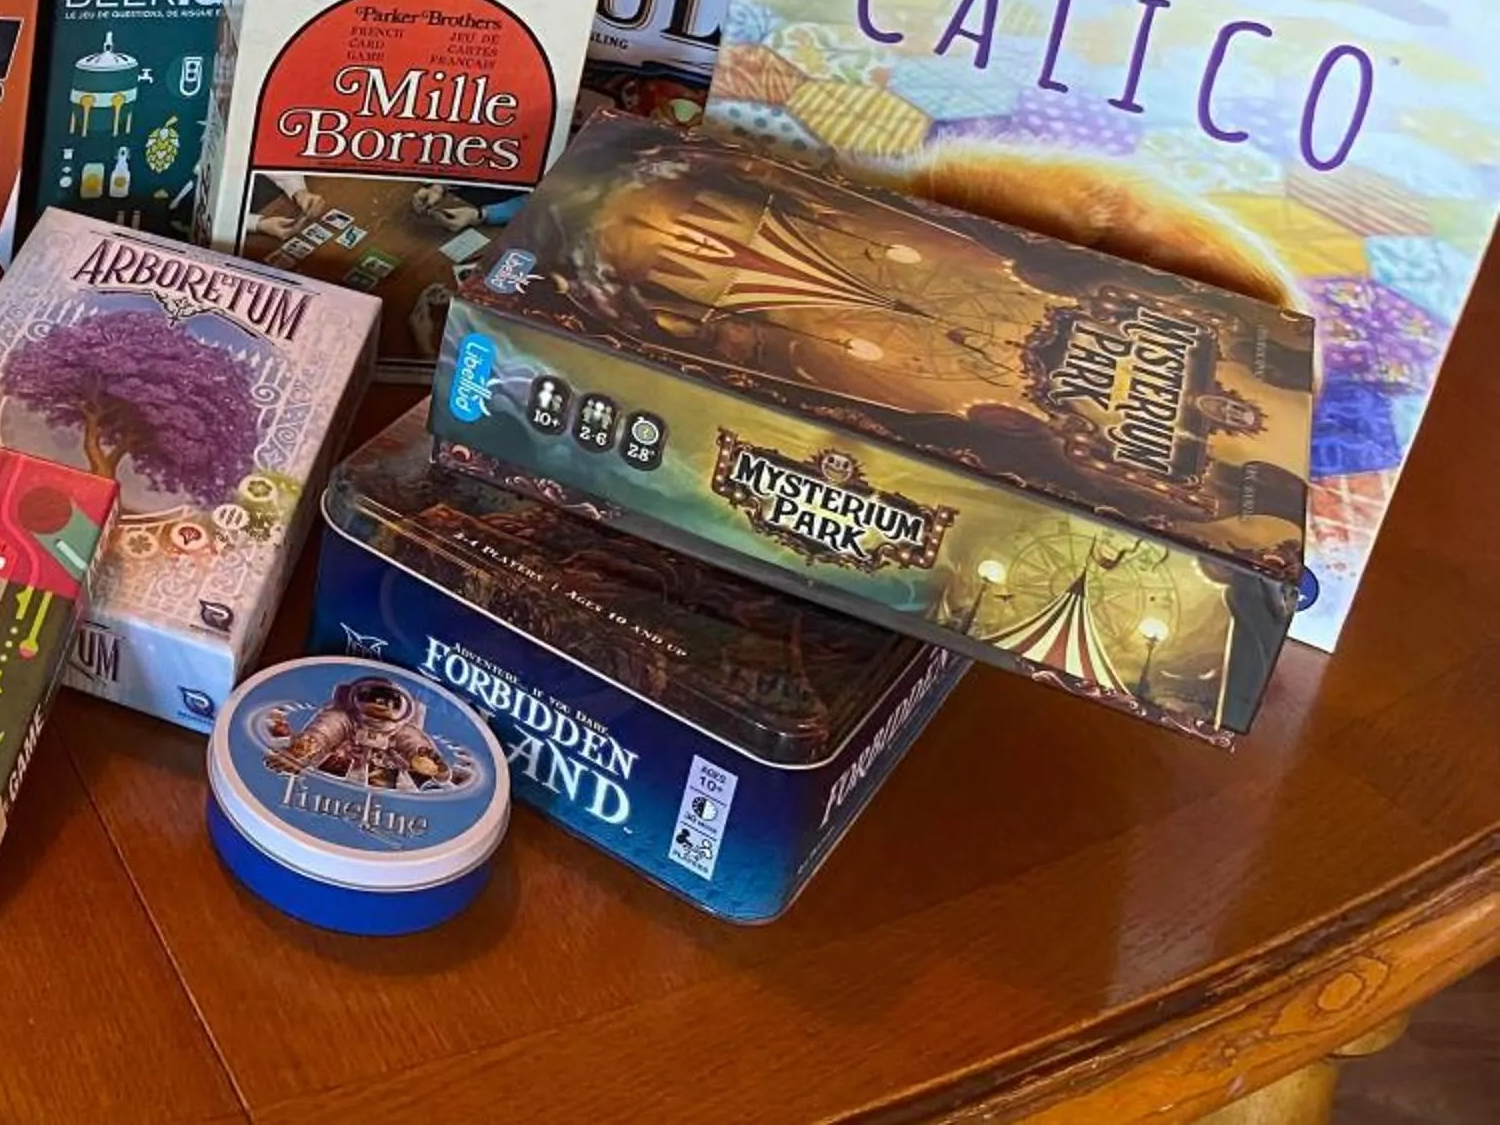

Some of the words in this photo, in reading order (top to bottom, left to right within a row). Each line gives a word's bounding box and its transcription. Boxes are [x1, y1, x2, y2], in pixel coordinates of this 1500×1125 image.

[78, 11, 96, 20] JEU
[348, 38, 385, 51] CARD
[351, 25, 404, 39] FRENCH
[355, 6, 421, 25] Parker
[421, 9, 503, 31] Brothers
[449, 31, 475, 43] JEU
[480, 33, 500, 44] DE
[590, 35, 628, 51] LING
[346, 50, 385, 63] GAME
[447, 44, 499, 58] CARTES
[335, 65, 520, 129] Mille
[278, 106, 522, 172] Bornes
[72, 239, 312, 343] ARBORETUM
[452, 340, 494, 415] Libellud
[1048, 321, 1134, 412] PARK
[1107, 306, 1200, 475] MYSTERIUM
[533, 408, 561, 429] 10+
[579, 425, 608, 447] 2-6
[730, 451, 925, 545] MYSTERIUM
[769, 493, 873, 561] PARK
[481, 545, 544, 583] PLAYERS
[564, 589, 602, 613] AGES
[630, 624, 664, 646] AND
[667, 642, 689, 658] UP
[417, 635, 640, 781] FORBIDDEN
[9, 703, 45, 803] GAME
[277, 772, 430, 839] Timeline
